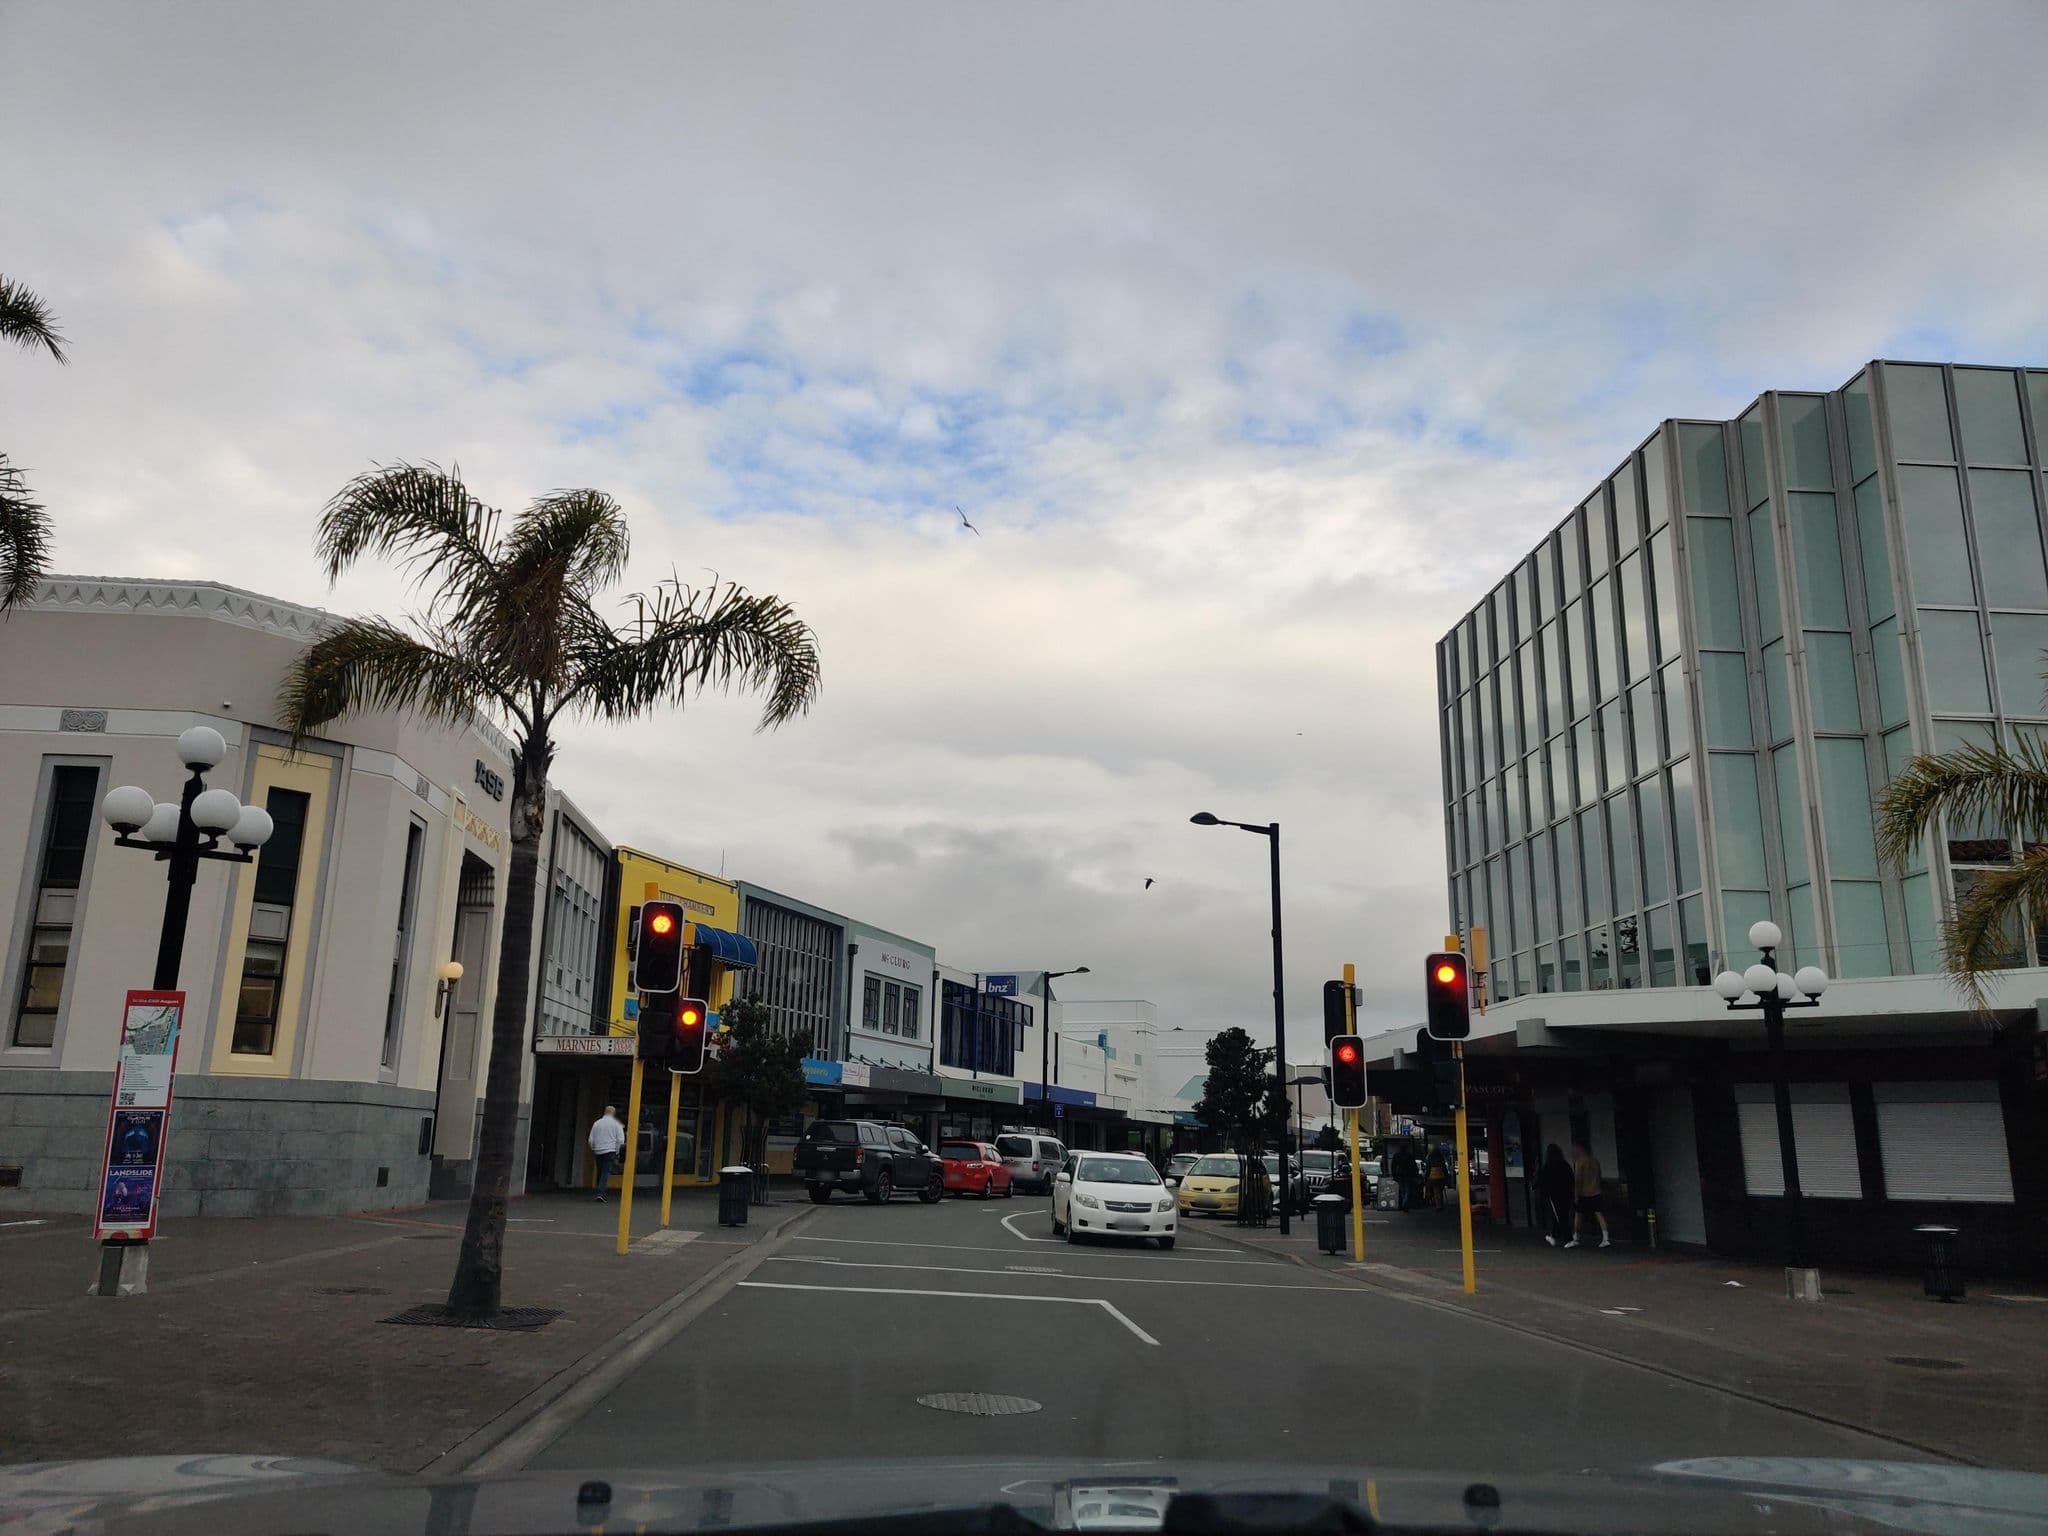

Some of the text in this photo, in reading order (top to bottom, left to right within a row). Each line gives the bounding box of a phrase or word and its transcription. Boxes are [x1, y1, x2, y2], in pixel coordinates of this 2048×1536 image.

[475, 759, 505, 802] ASB
[987, 981, 1009, 994] bnz
[555, 1039, 602, 1052] MARNIES
